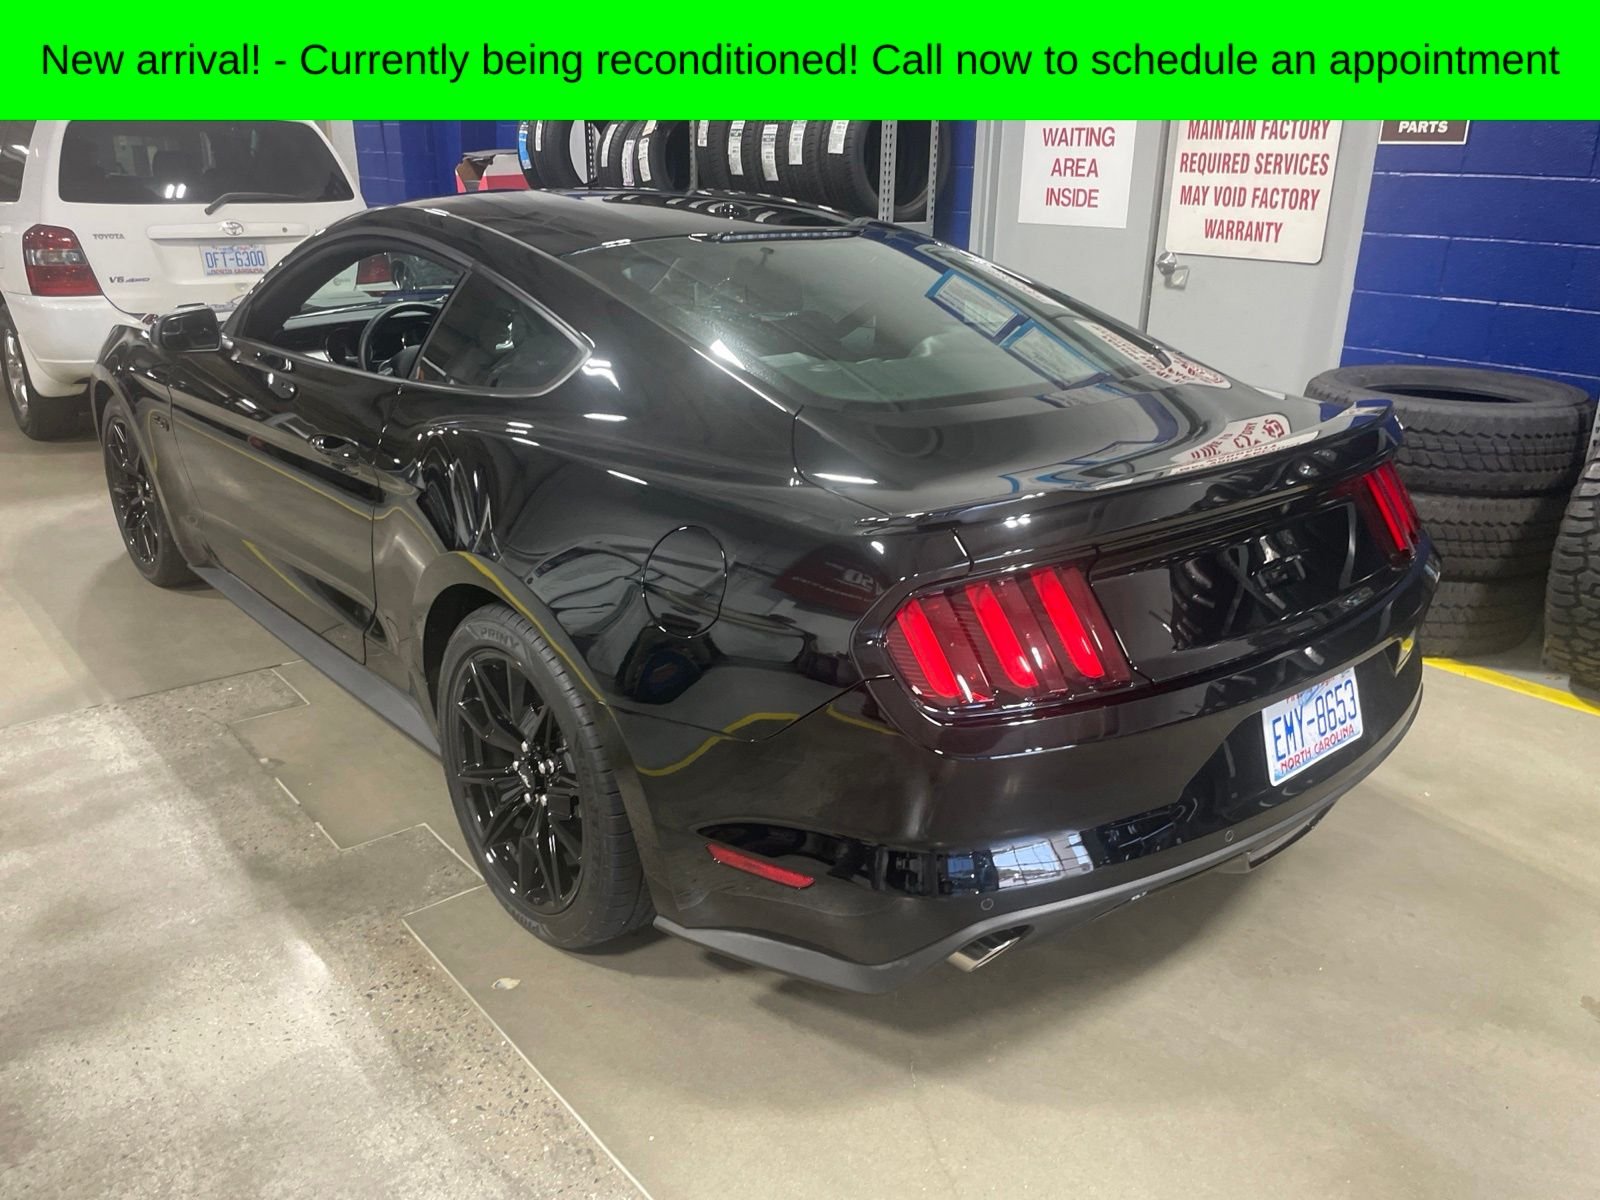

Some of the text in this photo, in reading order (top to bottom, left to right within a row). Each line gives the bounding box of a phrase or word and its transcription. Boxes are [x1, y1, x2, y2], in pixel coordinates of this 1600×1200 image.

[1042, 126, 1116, 147] WAITING
[1187, 120, 1331, 141] MAINTAIN FACTORY
[1398, 120, 1449, 133] PARTS
[1051, 157, 1099, 178] AREA
[1179, 152, 1330, 176] REQUIRED SERVICES
[1045, 187, 1099, 208] INSIDE
[1179, 185, 1320, 211] MAY VOID FACTORY
[92, 232, 125, 240] TOYOTA
[1204, 218, 1283, 243] WARRANTY
[1272, 679, 1358, 762] EMY-8653
[1280, 723, 1355, 774] NORTH CAROLINA
